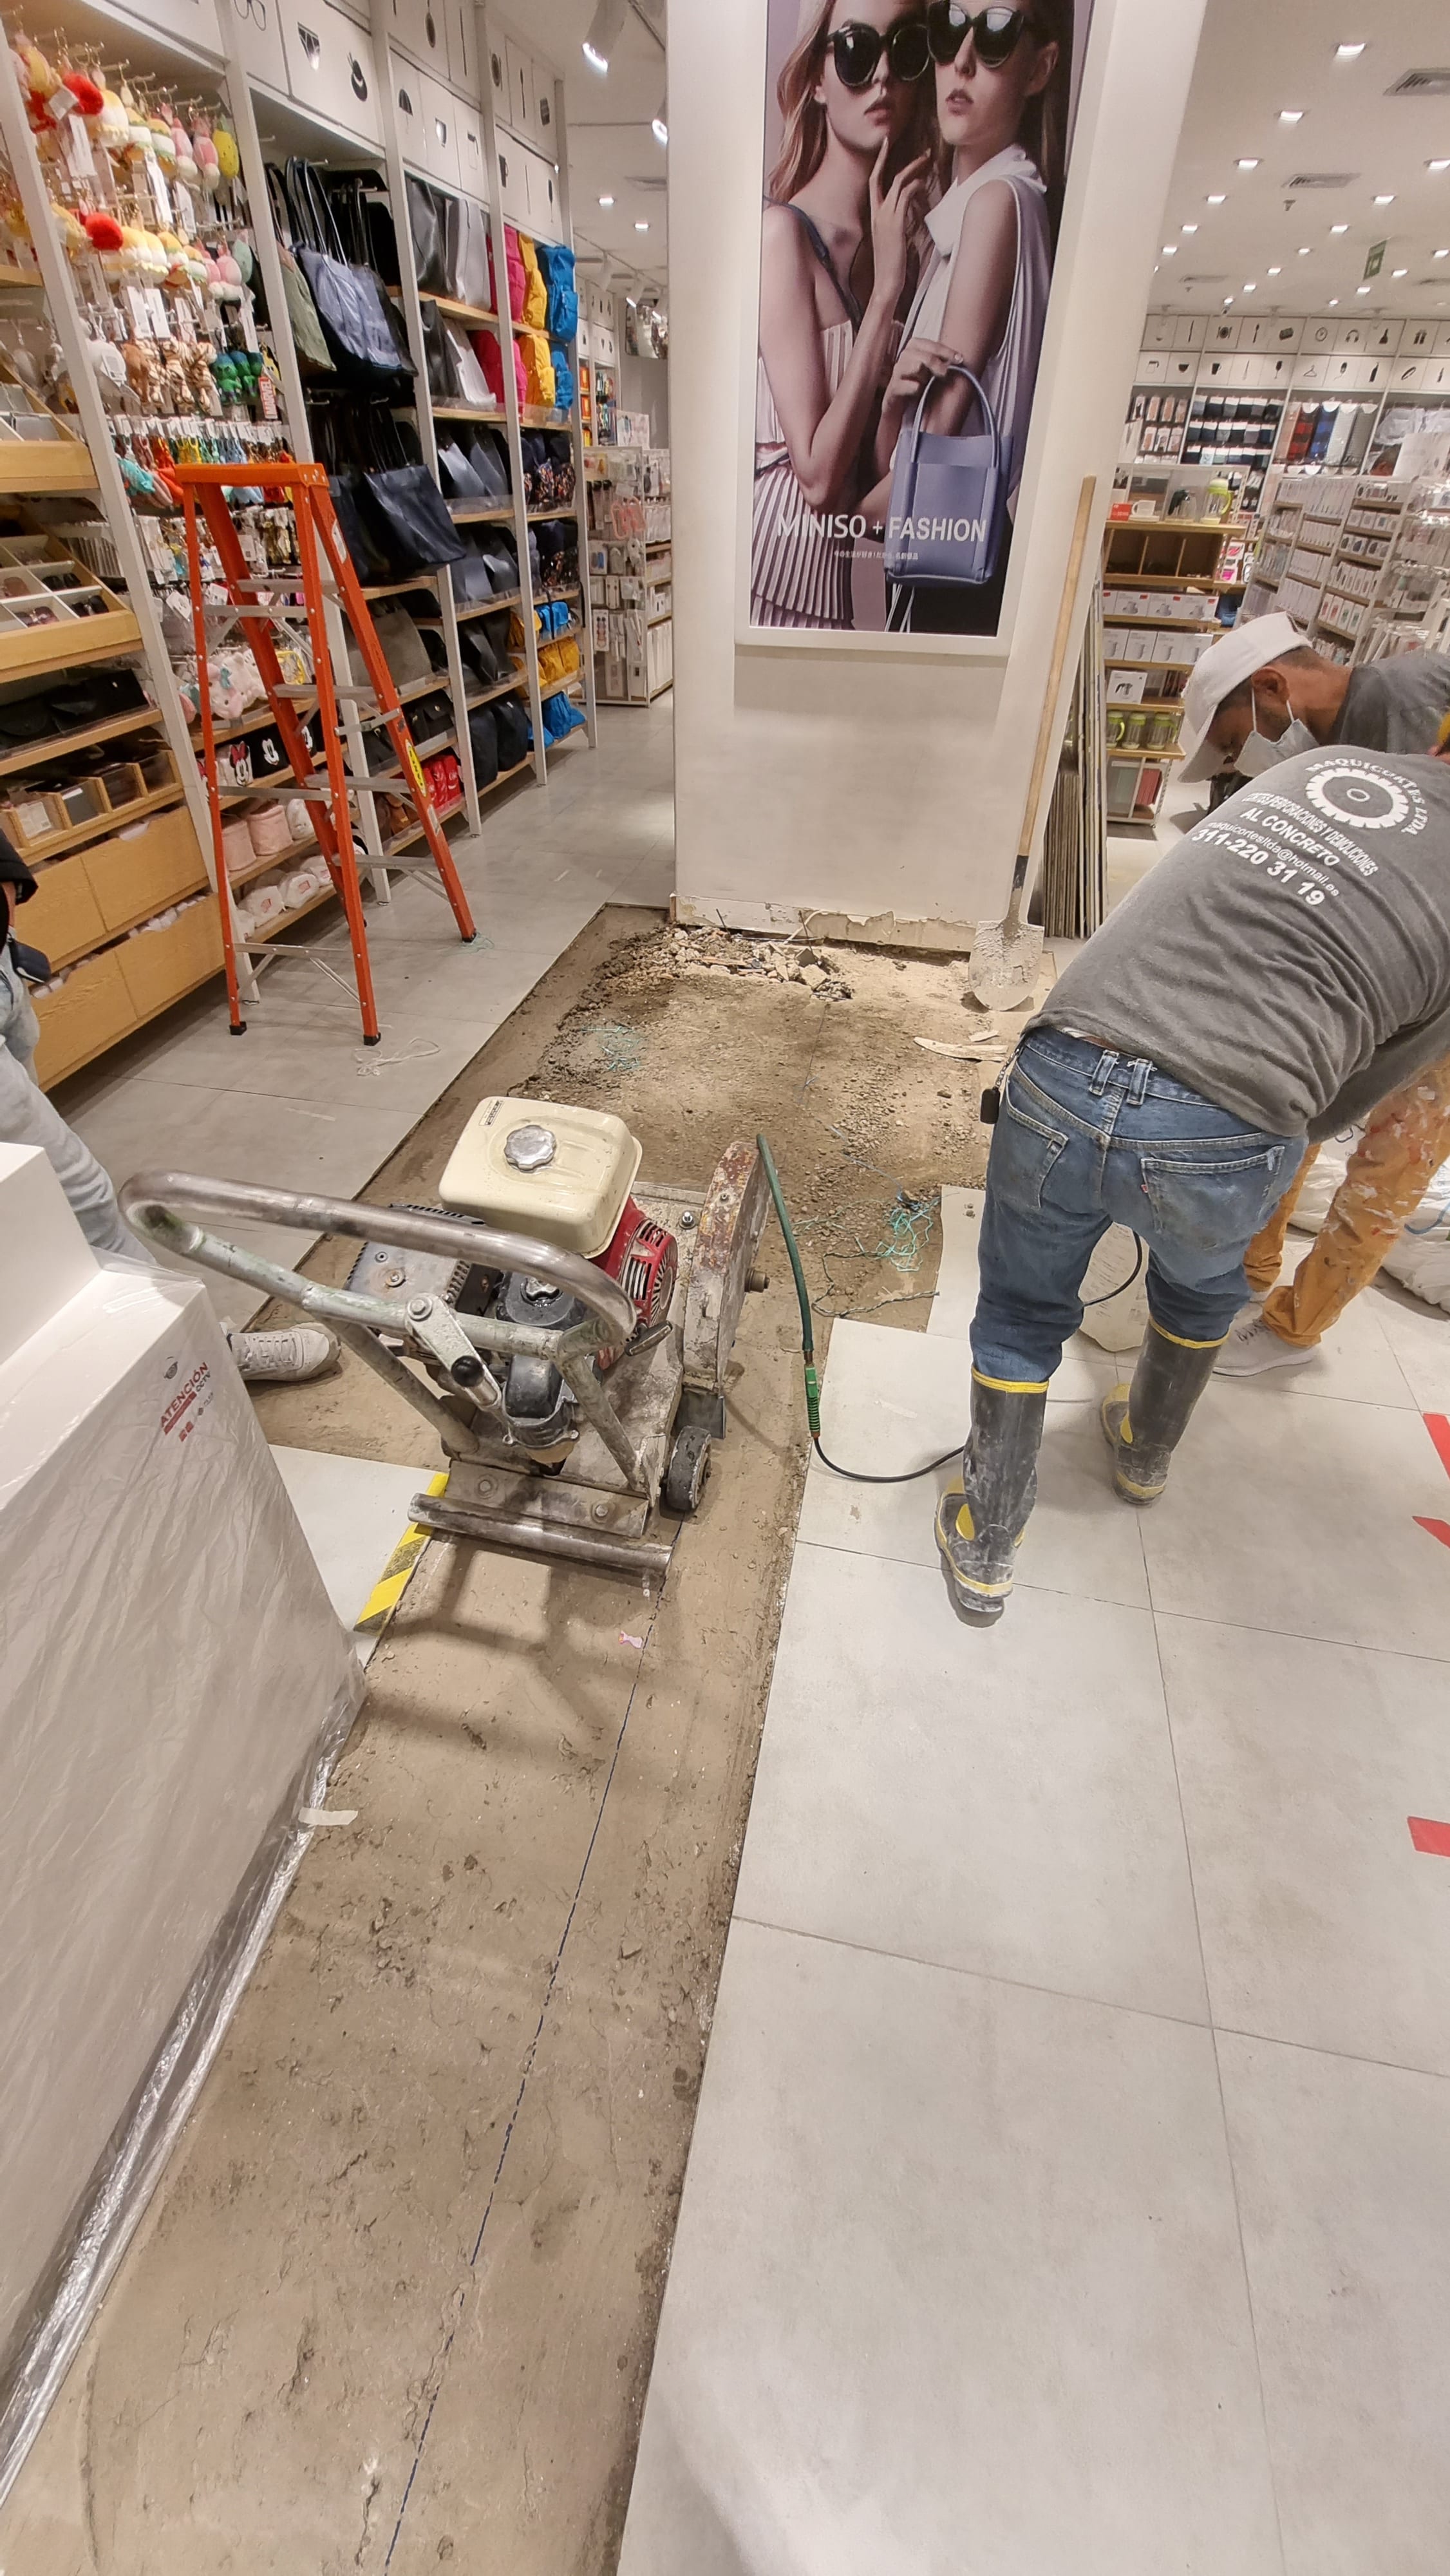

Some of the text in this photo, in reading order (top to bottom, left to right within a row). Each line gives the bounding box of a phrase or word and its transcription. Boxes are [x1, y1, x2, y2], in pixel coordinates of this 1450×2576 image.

[259, 379, 278, 415] MARVEL
[778, 514, 866, 539] MINISO
[888, 516, 987, 542] FASHION
[1239, 808, 1341, 866] AL CONCRETO
[1324, 830, 1379, 876] DEMOLICIONES
[1191, 828, 1325, 905] 311-220 31 19
[160, 1361, 209, 1428] ATENCIÓN
